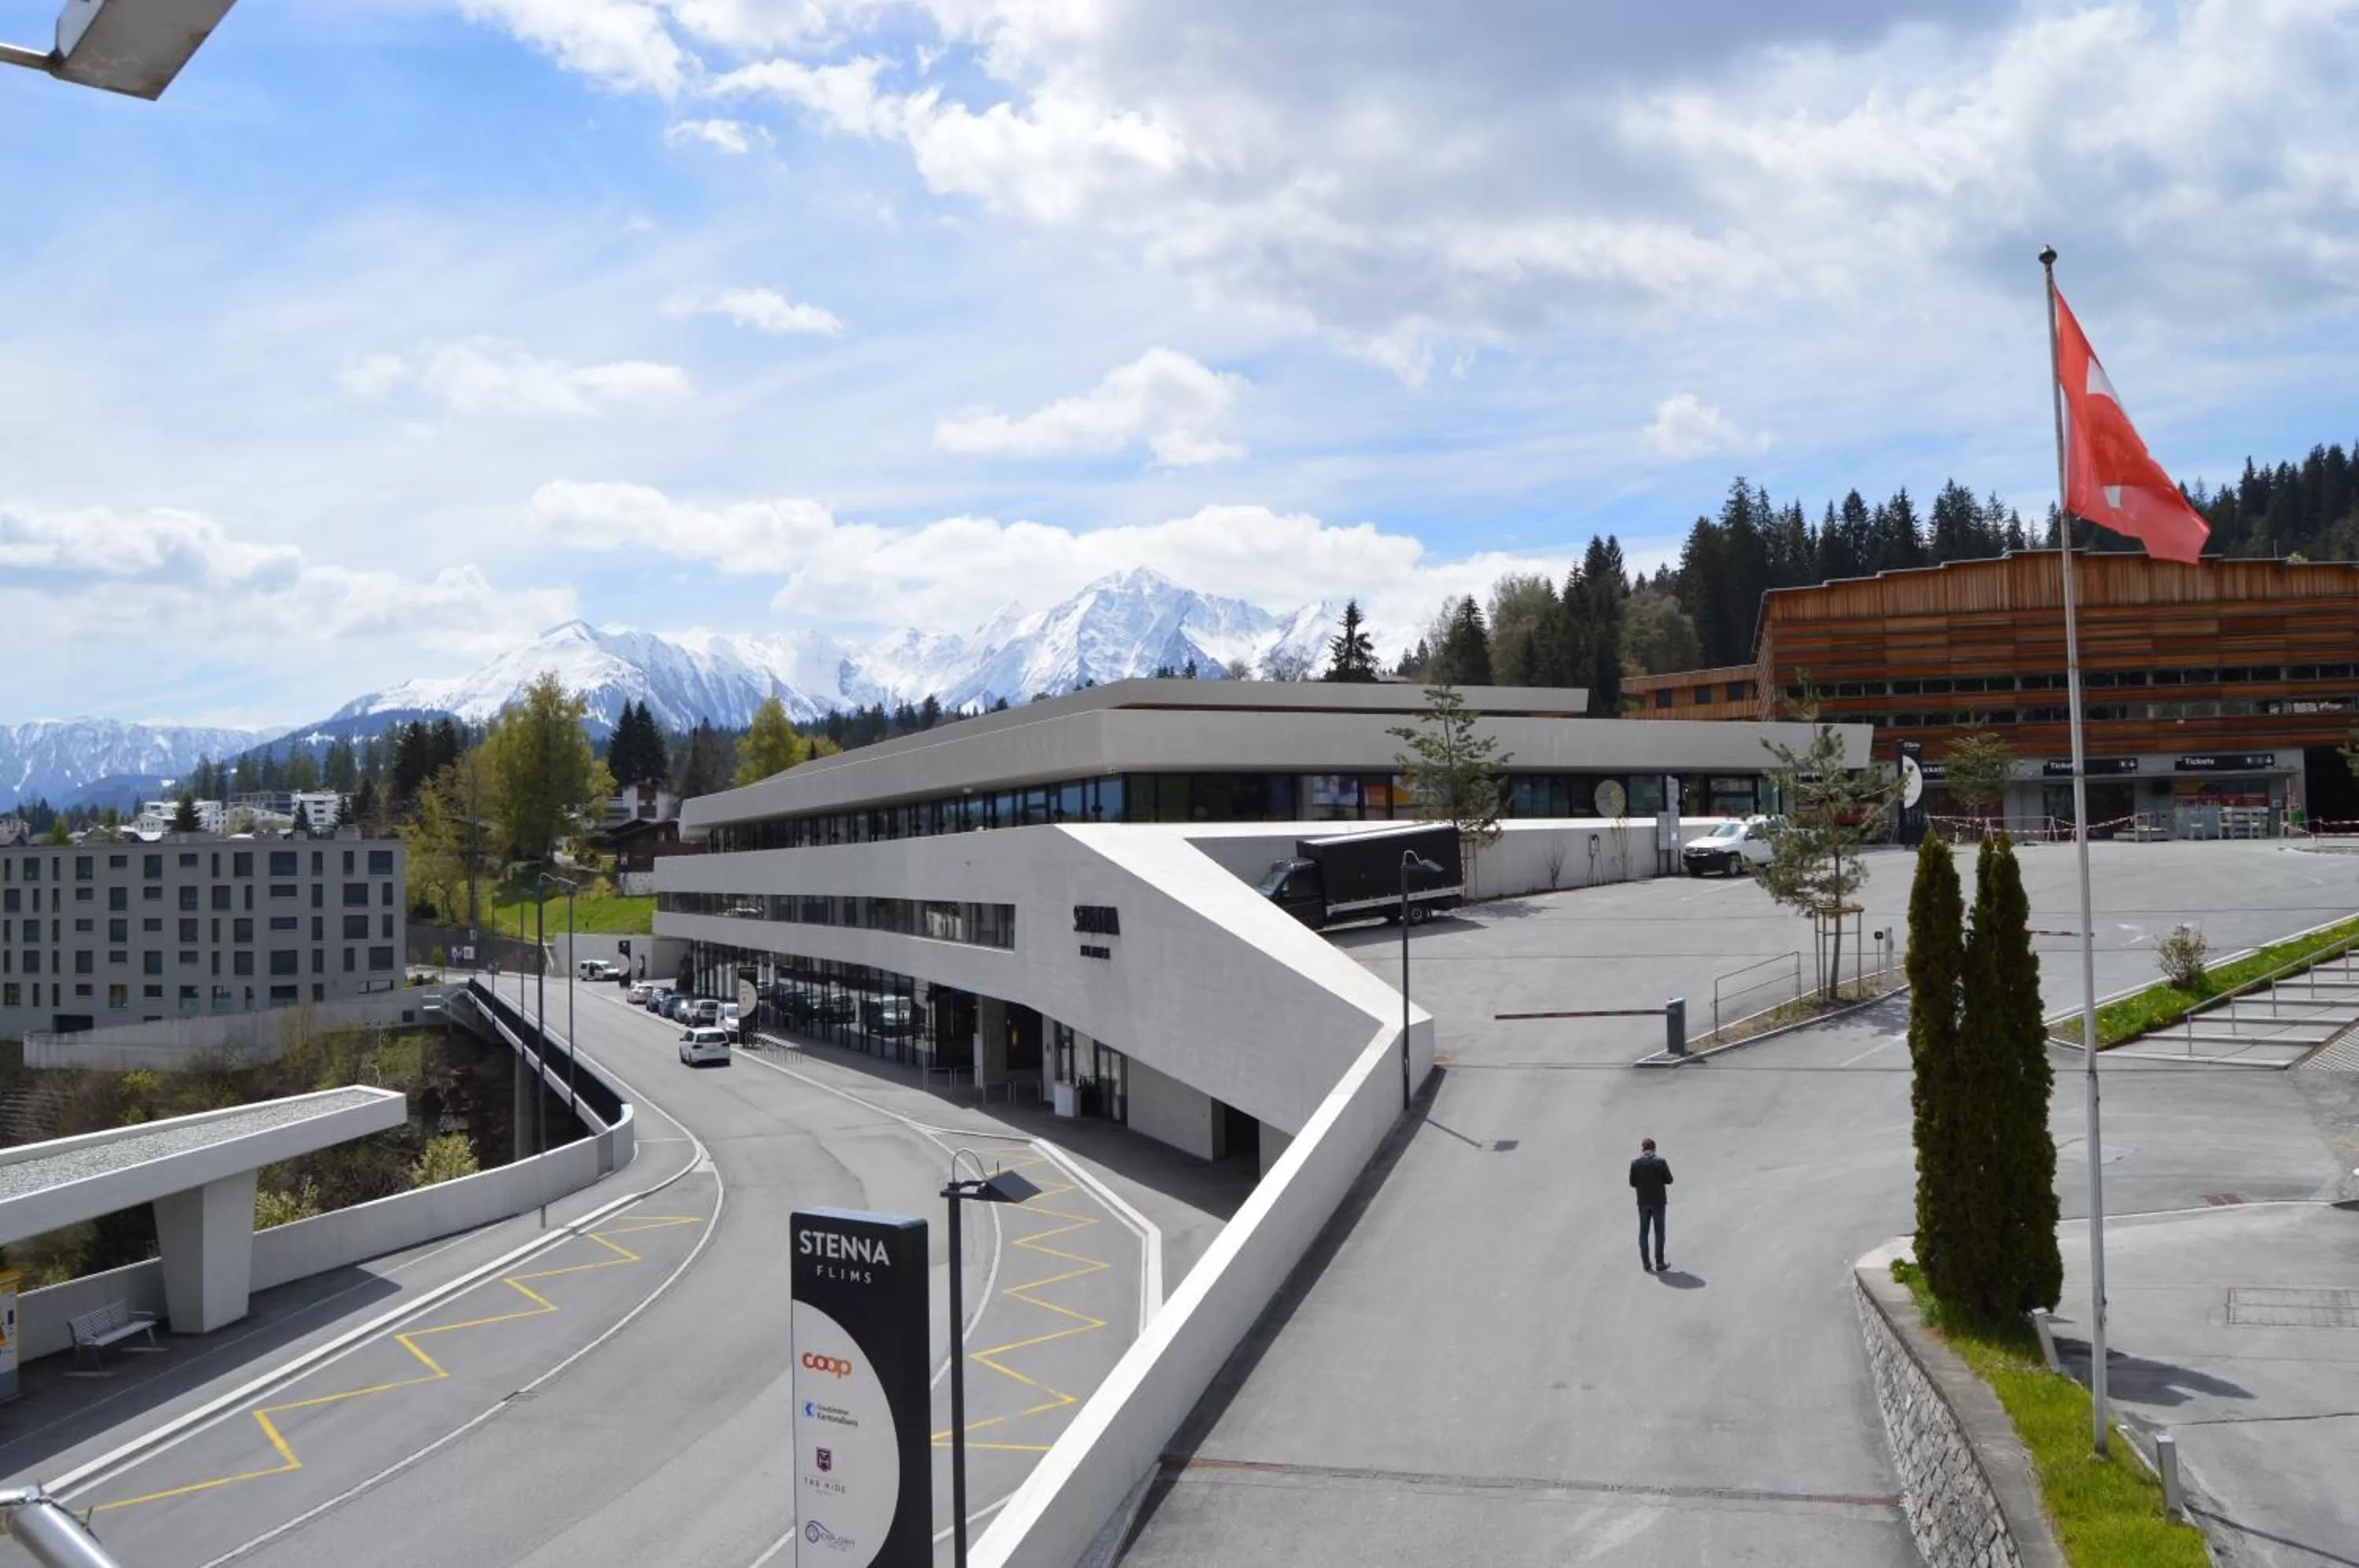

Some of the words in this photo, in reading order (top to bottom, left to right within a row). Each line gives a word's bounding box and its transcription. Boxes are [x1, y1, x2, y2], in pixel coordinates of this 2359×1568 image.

[2185, 757, 2215, 766] Tickets
[799, 1229, 891, 1267] STENNA
[817, 1264, 872, 1284] FLIMS
[802, 1352, 852, 1378] coop
